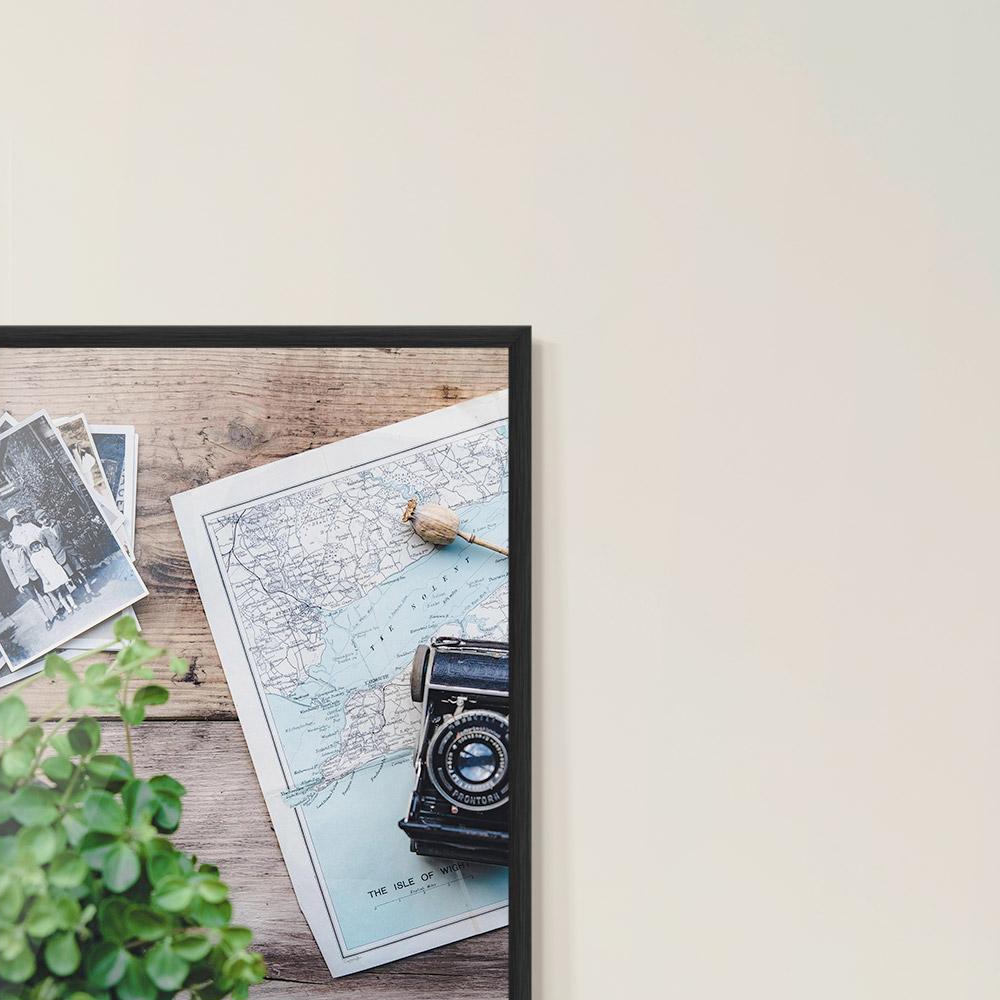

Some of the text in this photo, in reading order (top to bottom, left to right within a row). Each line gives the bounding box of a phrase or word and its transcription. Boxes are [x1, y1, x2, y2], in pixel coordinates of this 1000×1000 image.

[367, 886, 388, 899] THE
[393, 877, 415, 891] ISLE
[420, 870, 434, 882] OF
